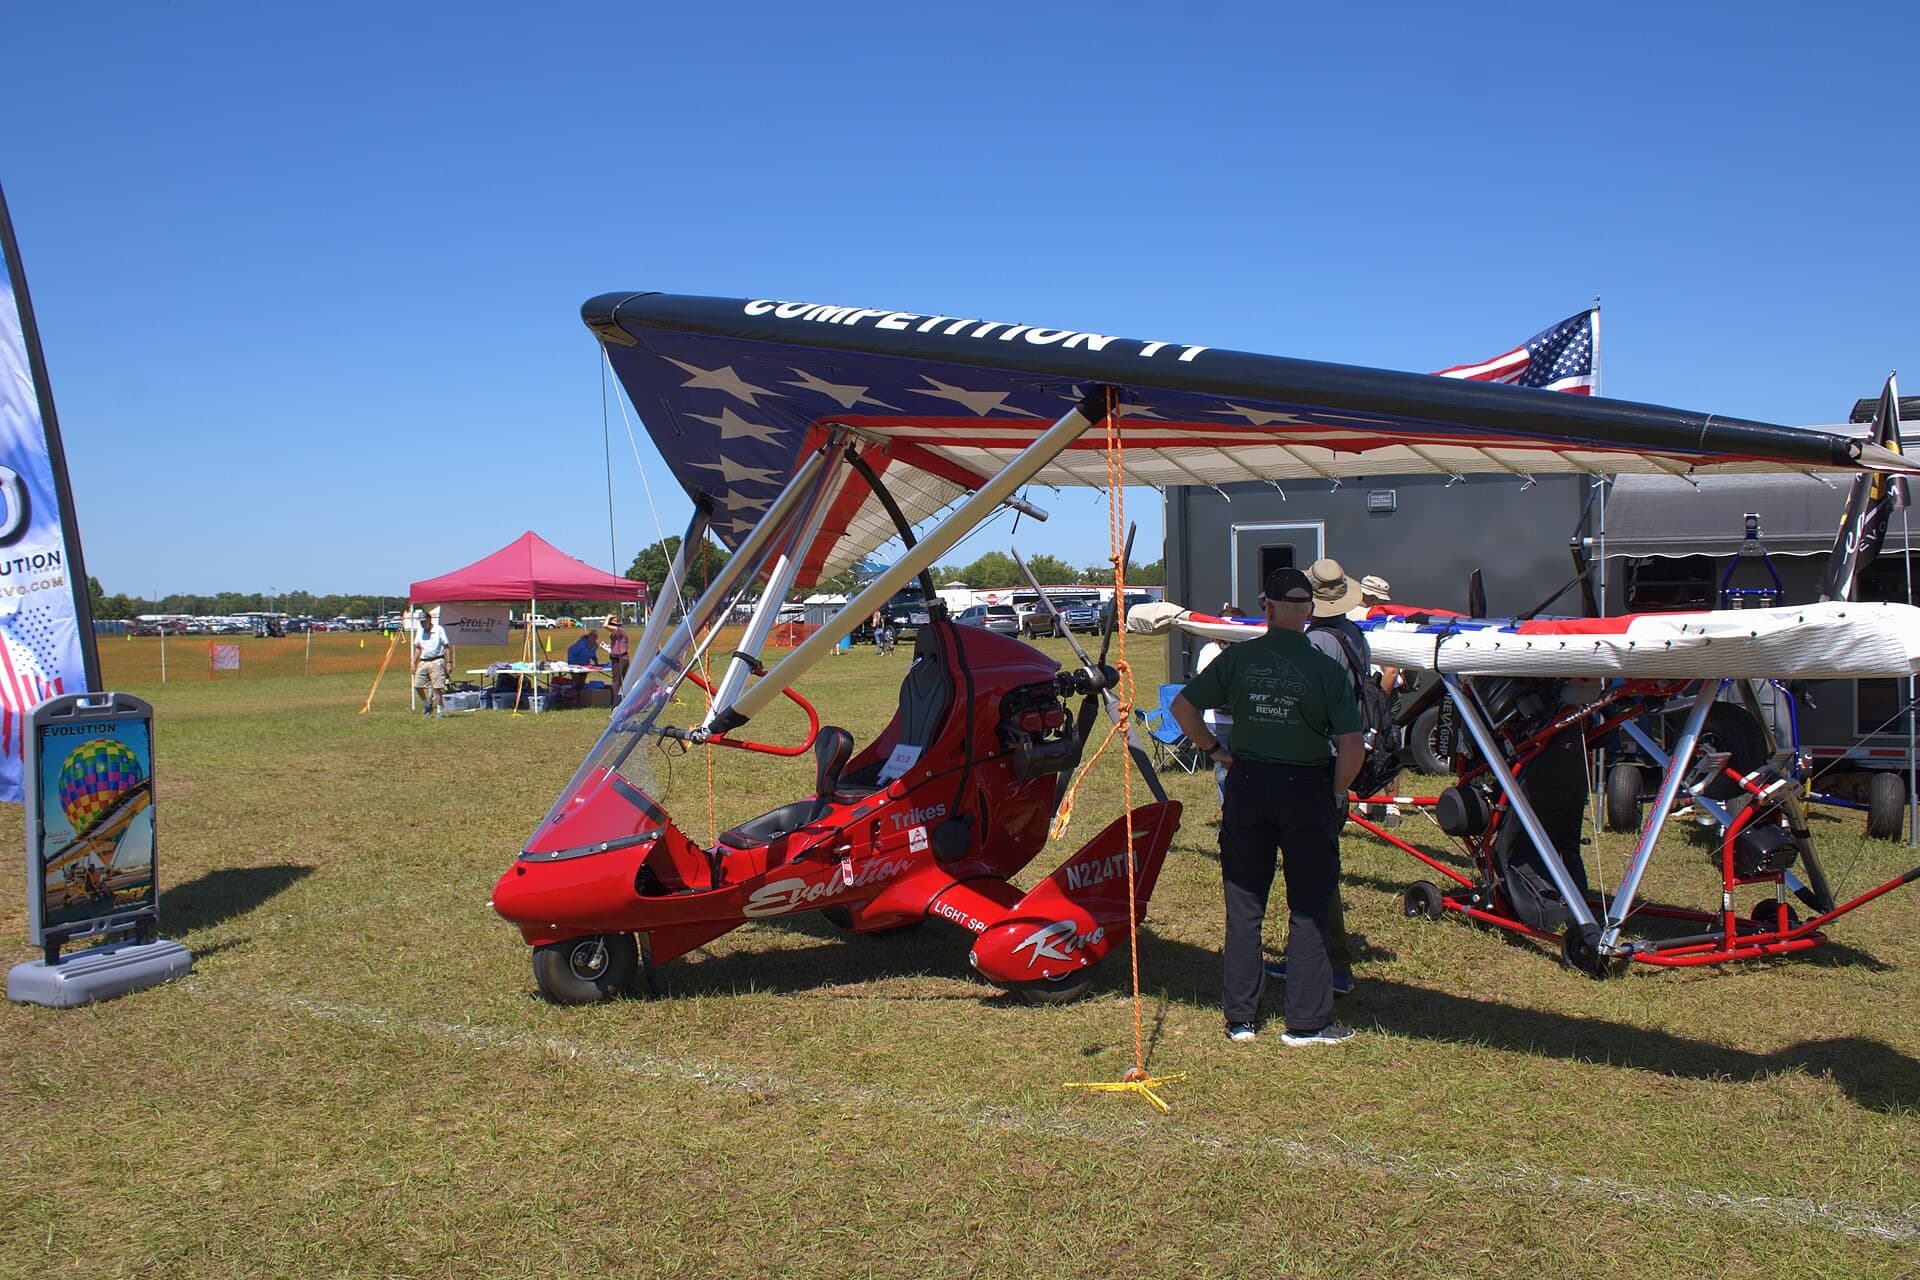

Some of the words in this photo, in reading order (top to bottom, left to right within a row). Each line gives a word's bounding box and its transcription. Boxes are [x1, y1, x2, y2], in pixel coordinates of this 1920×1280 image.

[43, 723, 116, 738] EVOLUTION
[890, 803, 946, 831] Trikes
[933, 900, 968, 925] LIGHT
